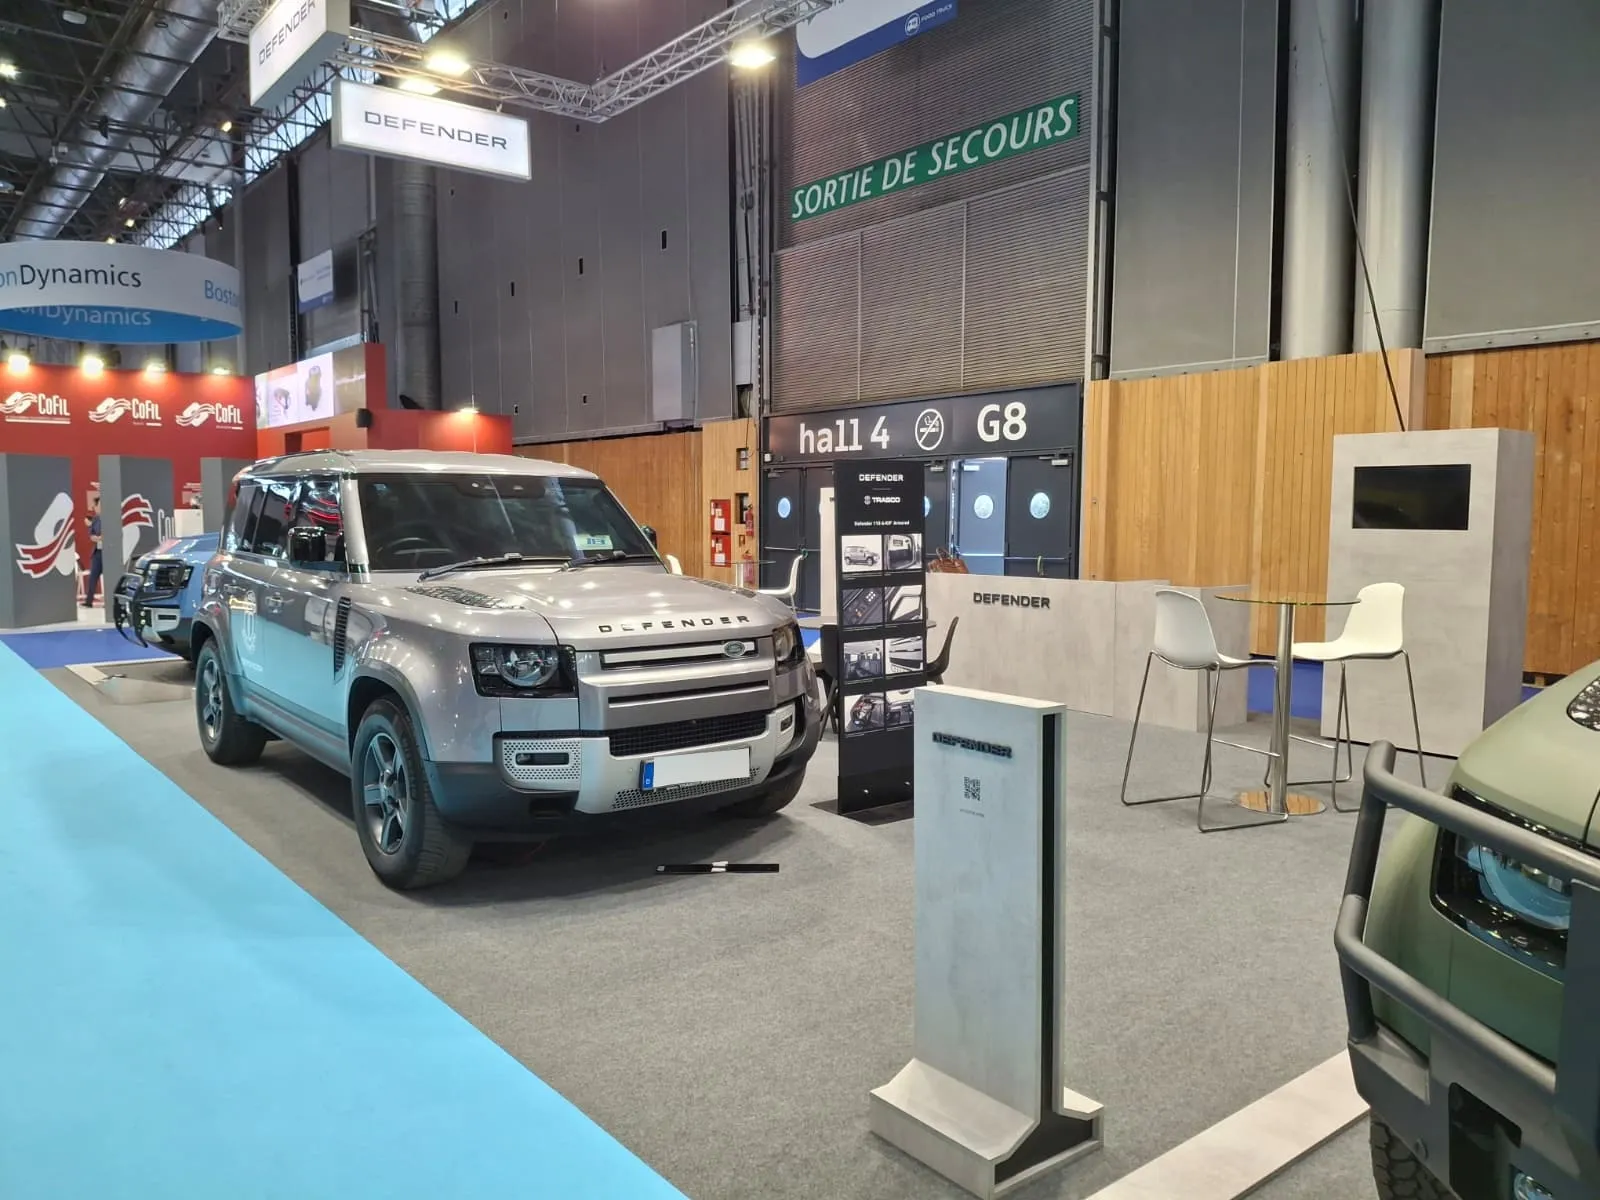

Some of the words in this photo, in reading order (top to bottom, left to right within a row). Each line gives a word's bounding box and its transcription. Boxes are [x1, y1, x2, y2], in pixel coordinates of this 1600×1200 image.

[364, 110, 508, 150] DEFENDER
[791, 165, 874, 219] SORTIE
[881, 150, 918, 191] DE
[927, 98, 1075, 176] SECOURS
[799, 418, 863, 454] hall
[870, 415, 890, 449] 4
[977, 401, 1027, 443] G8
[858, 473, 904, 482] DEFENDER
[973, 592, 1050, 609] DEFENDER
[932, 731, 1012, 759] DEFENDER
